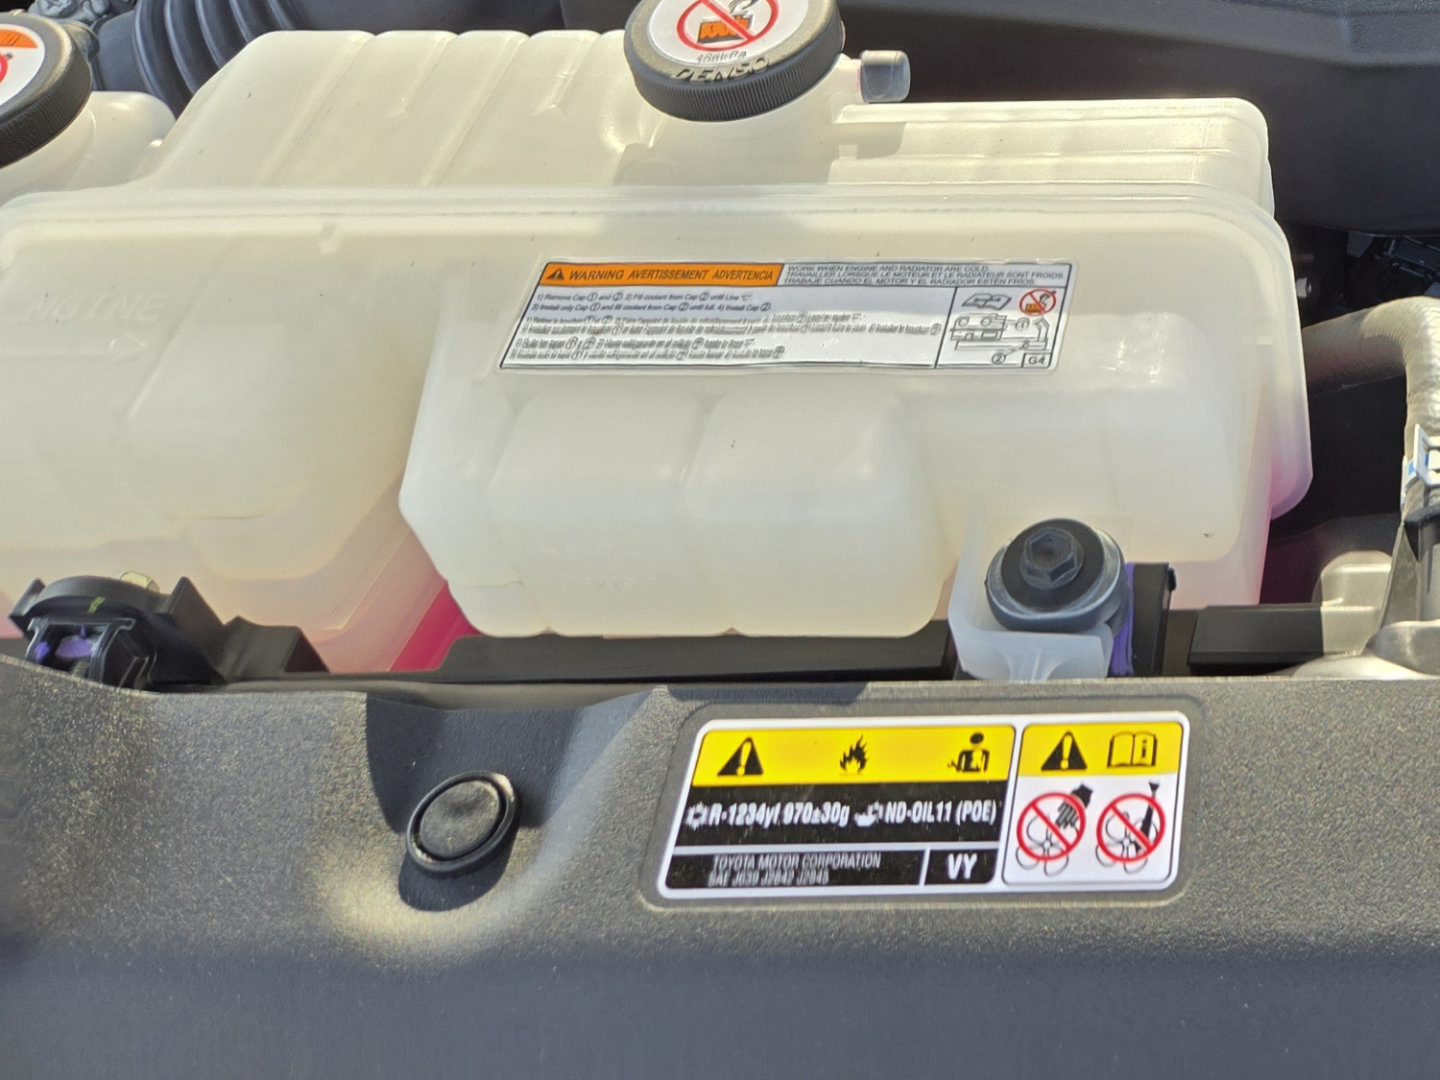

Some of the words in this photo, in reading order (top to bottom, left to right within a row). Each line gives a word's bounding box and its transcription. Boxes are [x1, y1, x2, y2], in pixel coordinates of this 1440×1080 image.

[671, 55, 770, 82] DENSO
[570, 270, 624, 280] WARNING
[628, 269, 709, 280] AVERTISSEMENT
[713, 269, 773, 280] ADVERTENCIA
[1028, 356, 1045, 365] G4
[956, 799, 997, 825] (POE)
[713, 853, 755, 871] TOYOTA
[758, 853, 799, 870] MOTOR
[802, 851, 881, 870] CORPORATION
[947, 853, 978, 880] VY
